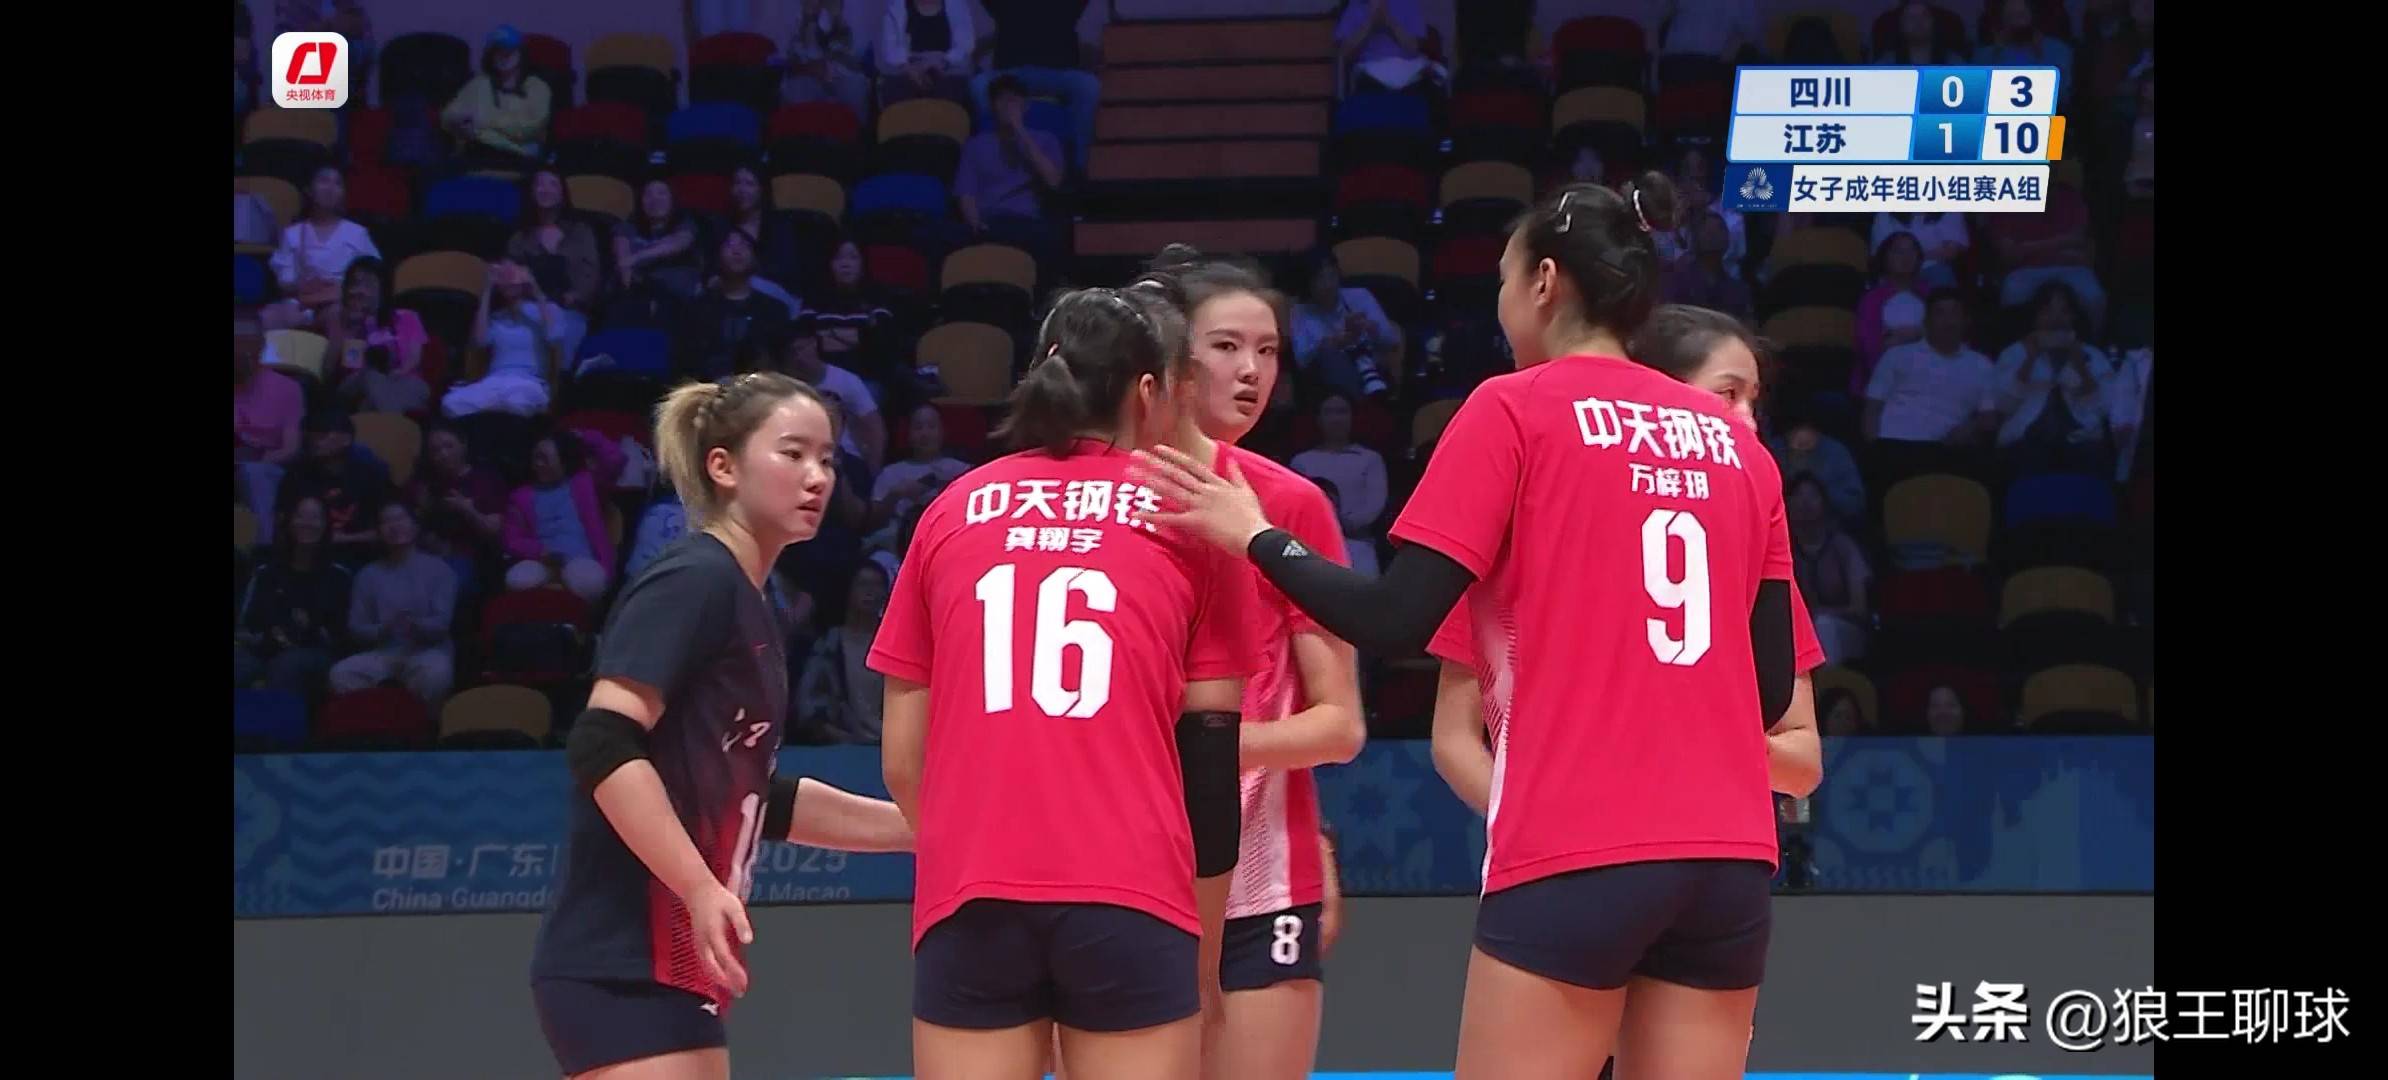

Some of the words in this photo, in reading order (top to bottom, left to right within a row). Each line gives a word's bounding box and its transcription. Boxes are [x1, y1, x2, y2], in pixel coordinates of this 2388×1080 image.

[1573, 396, 1742, 469] 中天钢铁
[1628, 462, 1710, 500] 万梓玥
[1641, 508, 1711, 666] 9
[975, 563, 1118, 718] 16
[373, 885, 442, 911] China
[1271, 914, 1303, 965] 8
